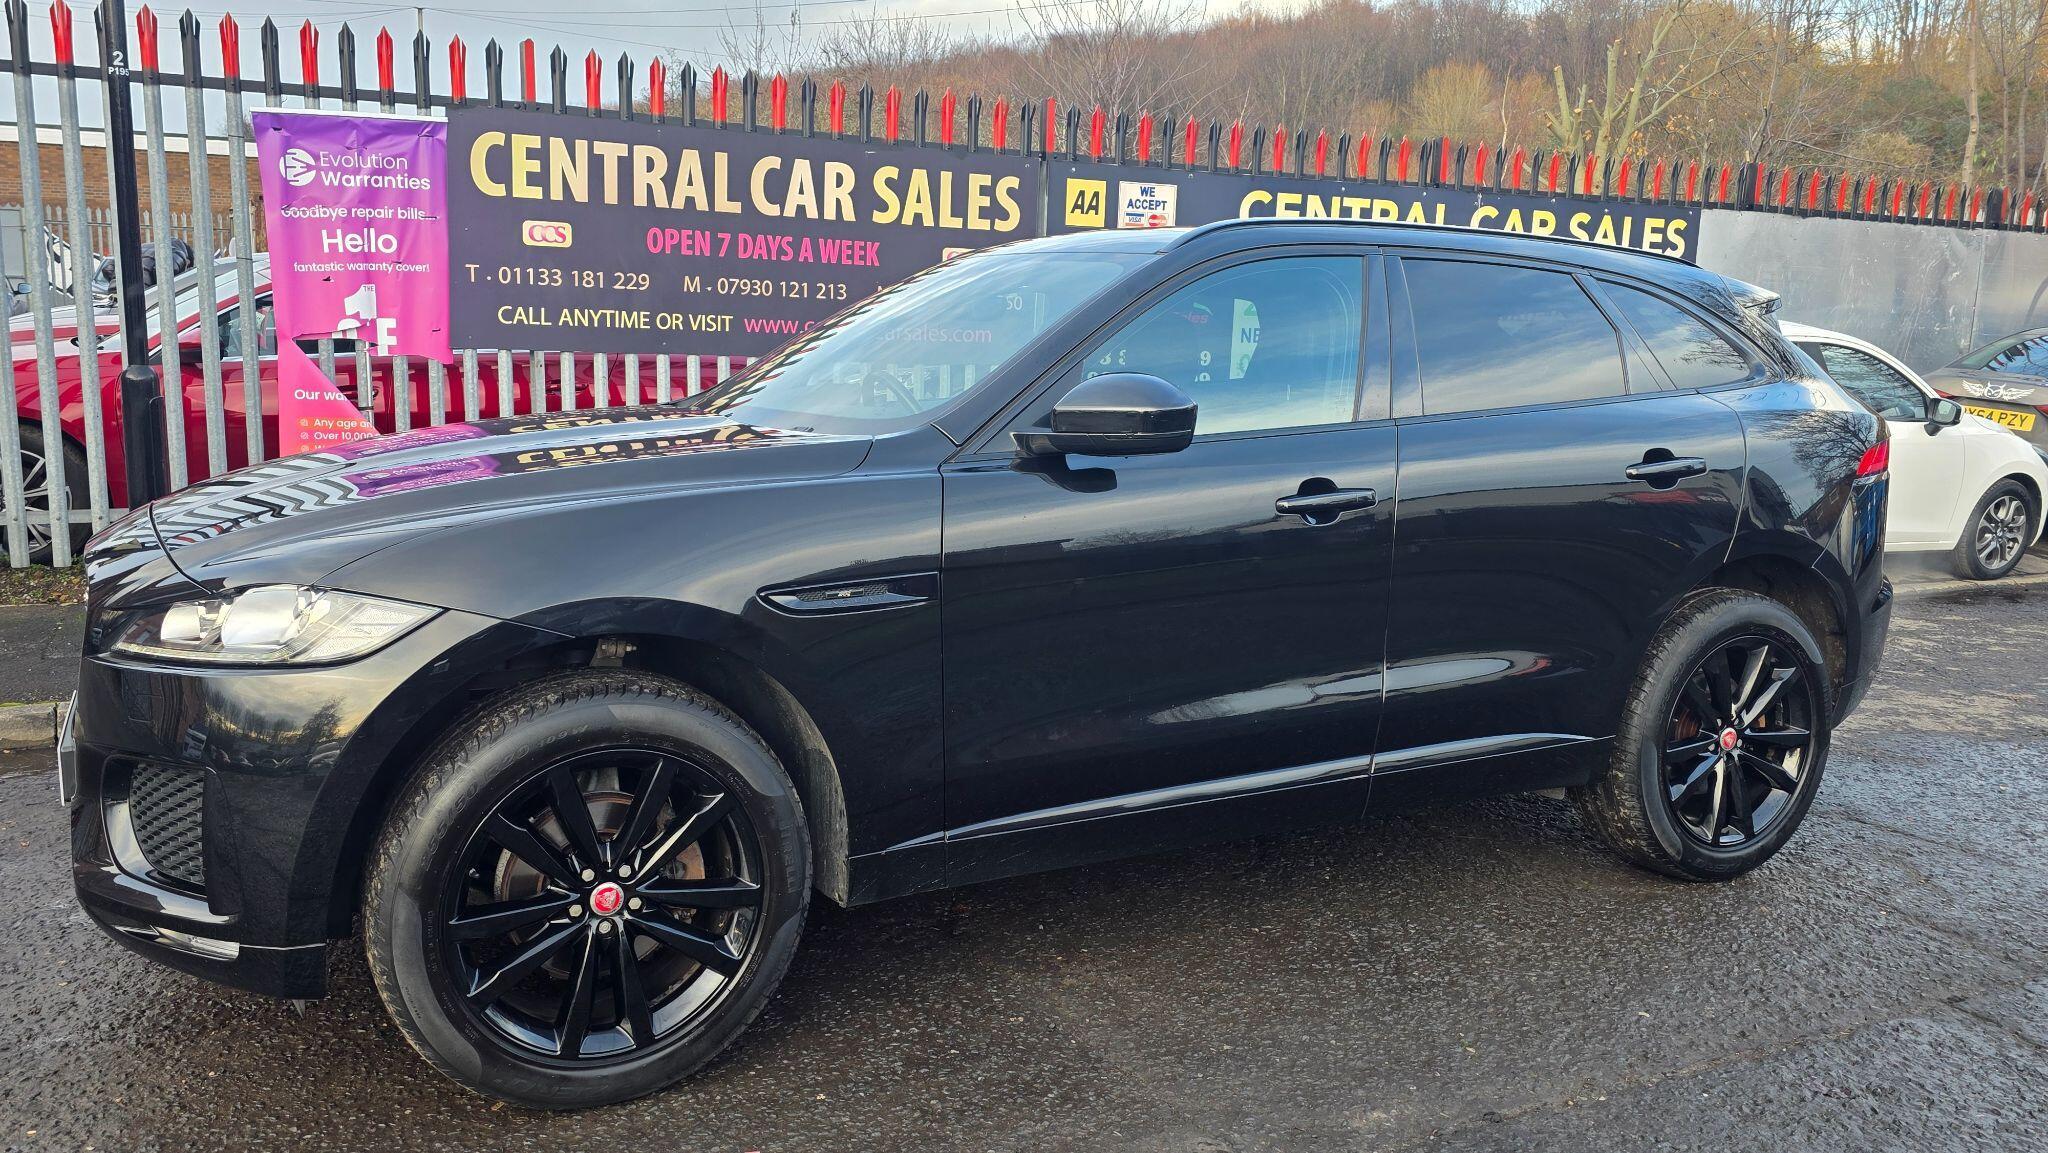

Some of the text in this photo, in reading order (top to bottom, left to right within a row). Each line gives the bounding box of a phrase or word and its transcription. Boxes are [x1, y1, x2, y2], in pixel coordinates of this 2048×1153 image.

[112, 50, 124, 66] 2
[108, 66, 130, 76] P195
[320, 151, 408, 170] Evolution
[320, 171, 431, 190] Warranties
[470, 131, 1021, 232] CENTRAL CAR SALES
[1140, 186, 1156, 198] WE
[1070, 189, 1099, 216] AA
[1127, 198, 1168, 211] ACCEPT
[281, 204, 347, 221] Goodbye
[352, 206, 394, 221] repair
[321, 228, 398, 253] Hello
[528, 224, 567, 243] CCS
[1569, 212, 1687, 258] SALES
[647, 227, 880, 267] OPEN 7 DAYS A WEEK
[294, 261, 344, 272] fantastic
[346, 262, 393, 274] warranty
[498, 266, 563, 287] 01133
[572, 270, 604, 289] 181
[613, 272, 650, 290] 229
[717, 277, 773, 297] 07930
[780, 281, 809, 299] 121
[816, 282, 847, 300] 213
[498, 305, 552, 326] CALL
[559, 308, 650, 329] ANYTIME
[656, 312, 683, 332] OR
[689, 314, 734, 332] VISIT
[294, 389, 349, 401] Our wa
[314, 418, 376, 430] Any age an
[1997, 412, 2029, 428] PZY
[314, 432, 339, 440] Over
